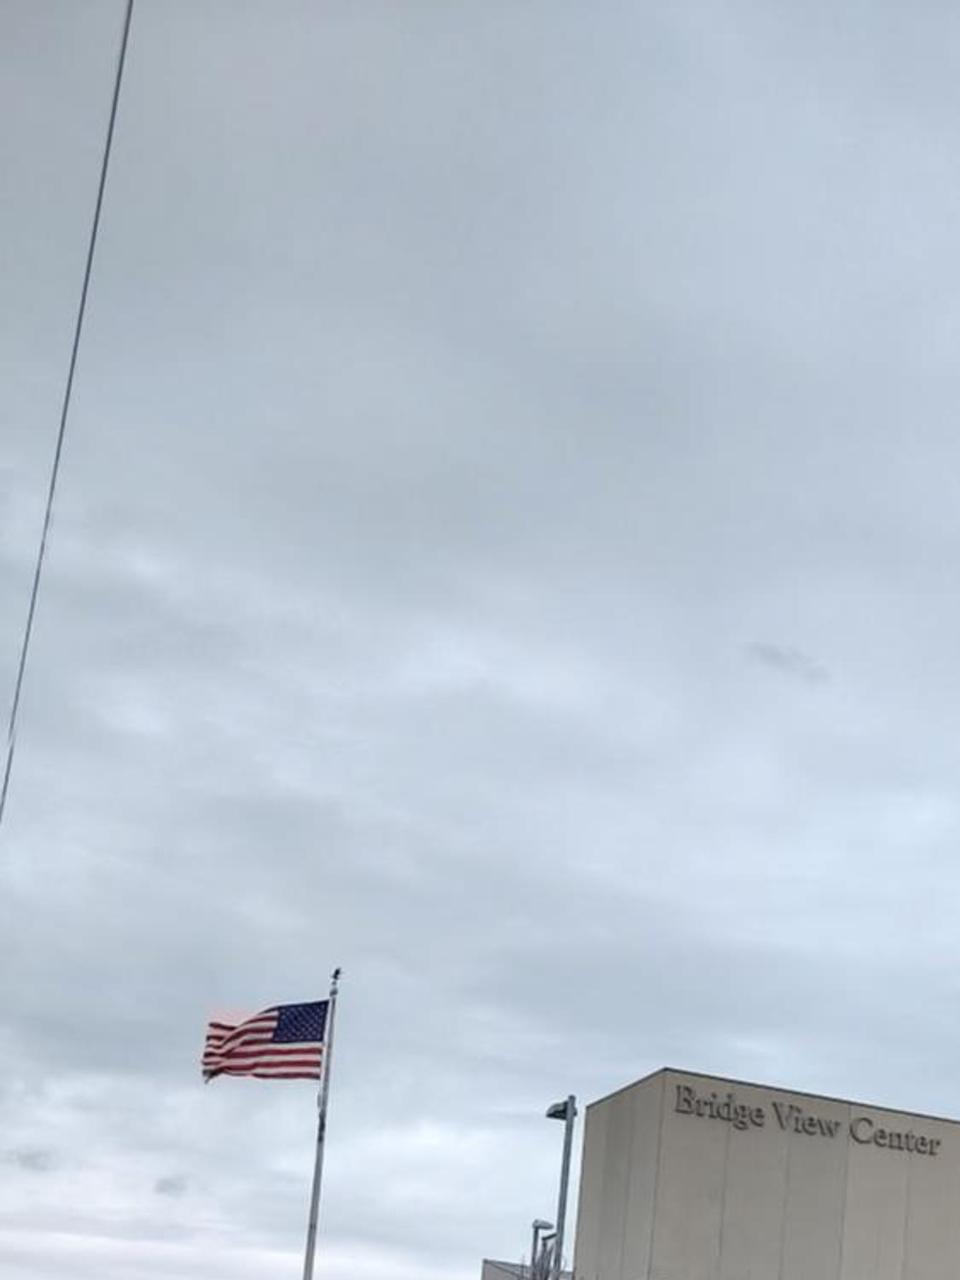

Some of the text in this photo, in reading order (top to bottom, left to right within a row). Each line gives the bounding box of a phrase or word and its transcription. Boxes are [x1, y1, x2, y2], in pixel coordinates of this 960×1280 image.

[674, 1084, 942, 1156] Bridge View Center
